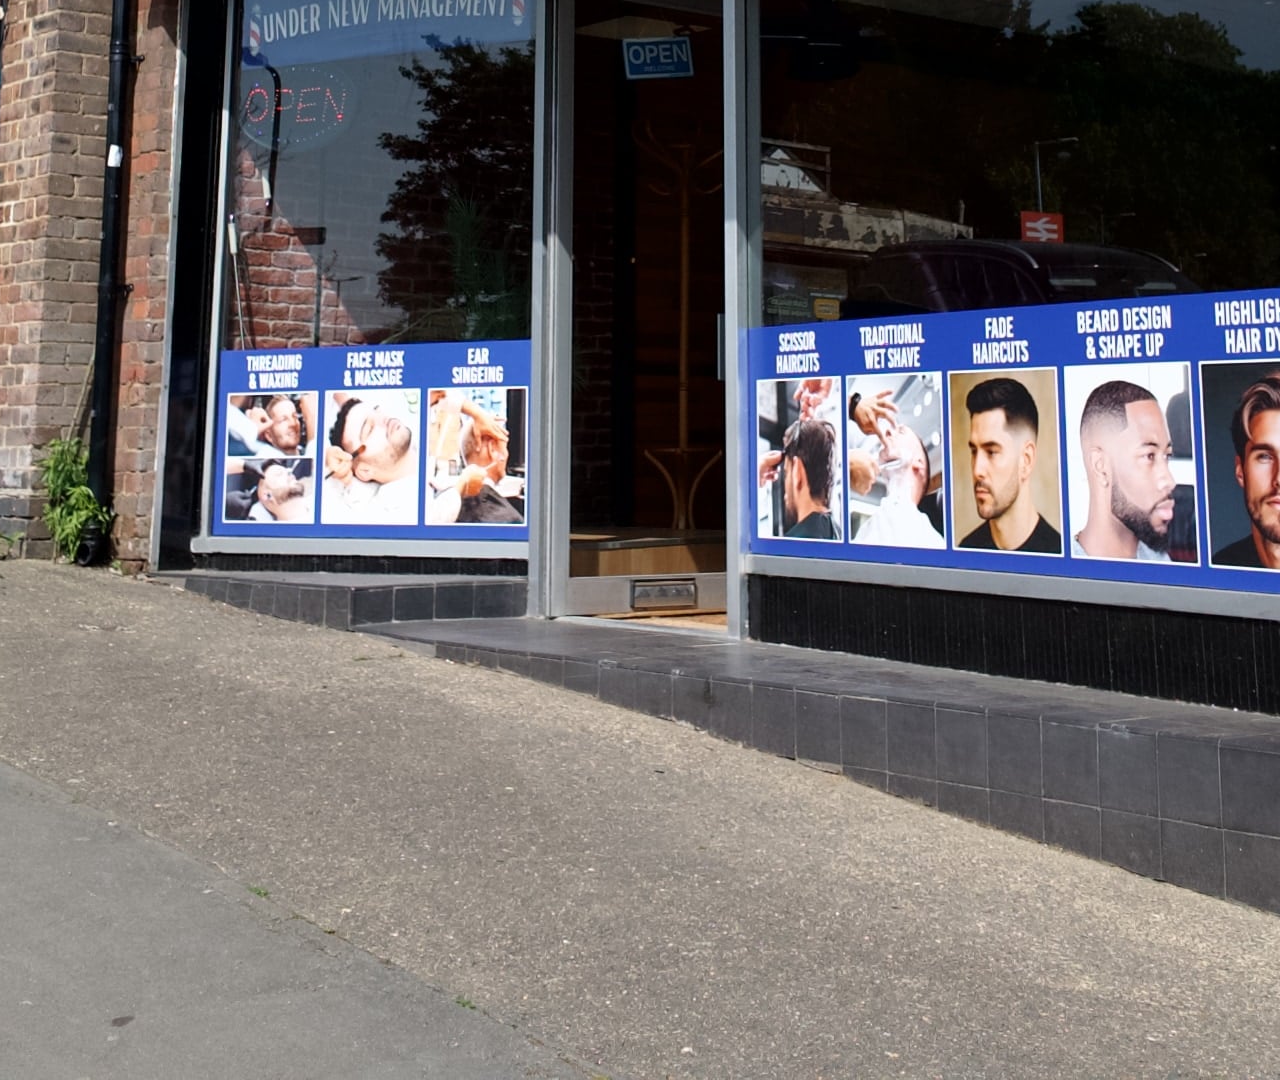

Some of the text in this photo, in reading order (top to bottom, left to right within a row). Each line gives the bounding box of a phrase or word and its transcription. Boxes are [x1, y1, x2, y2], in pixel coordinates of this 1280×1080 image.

[263, 3, 322, 43] UNDER
[629, 43, 688, 65] OPEN
[245, 87, 347, 123] OPEN
[985, 316, 1014, 339] FADE
[1077, 305, 1172, 334] BEARD DESIGN
[779, 331, 815, 352] SCISSOR
[859, 323, 925, 347] TRADITIONAL
[1086, 332, 1164, 359] & SHAPE UP
[1225, 328, 1262, 354] HAIR
[246, 353, 302, 371] THREADING
[347, 350, 405, 369] FACE MASK
[467, 348, 489, 364] EAR
[776, 353, 820, 374] HAIRCUTS
[865, 347, 920, 370] WET SHAVE
[972, 340, 1029, 365] HAIRCUTS
[249, 372, 299, 389] & WAXING
[344, 368, 403, 386] & MASSAGE
[452, 366, 503, 384] SINGEING
